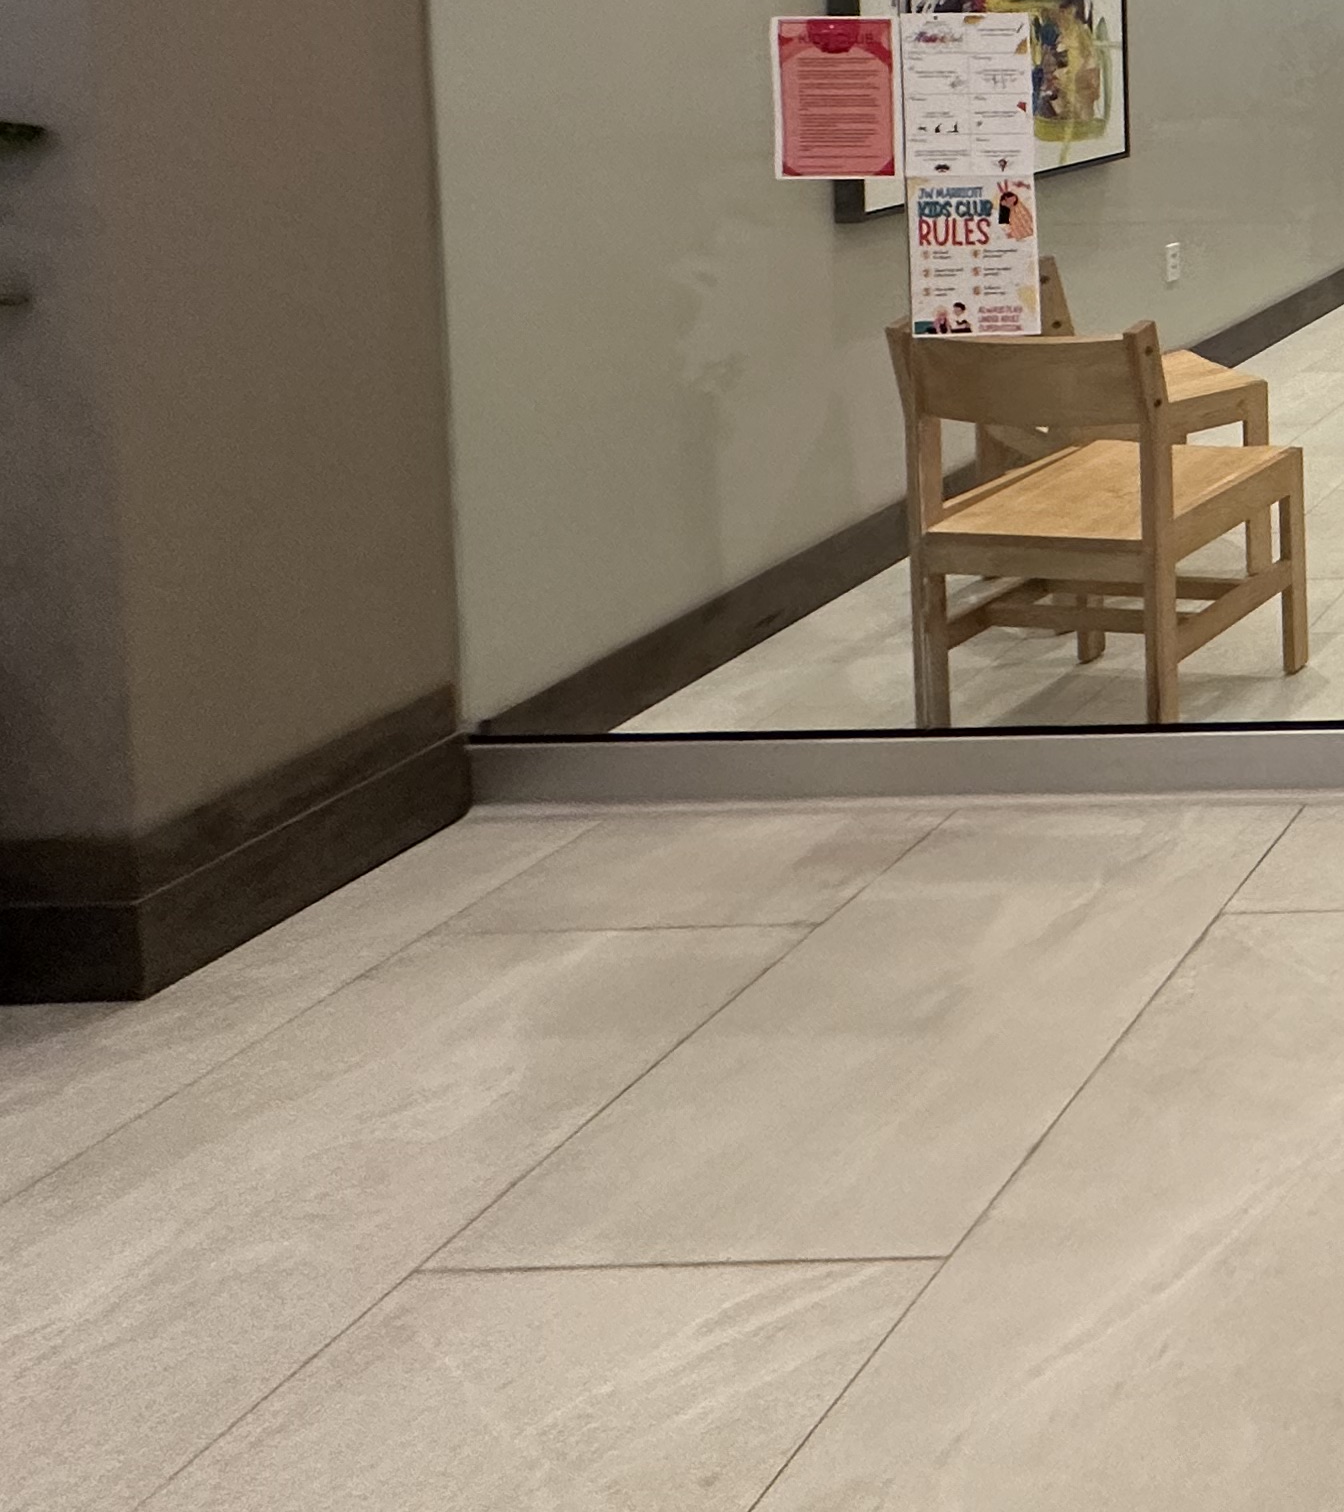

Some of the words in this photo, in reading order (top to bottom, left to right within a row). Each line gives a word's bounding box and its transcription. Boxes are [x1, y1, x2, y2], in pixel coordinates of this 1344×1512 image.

[918, 188, 934, 199] JW
[917, 200, 952, 218] KIDS
[955, 199, 993, 218] CLUB
[918, 217, 990, 246] RULES
